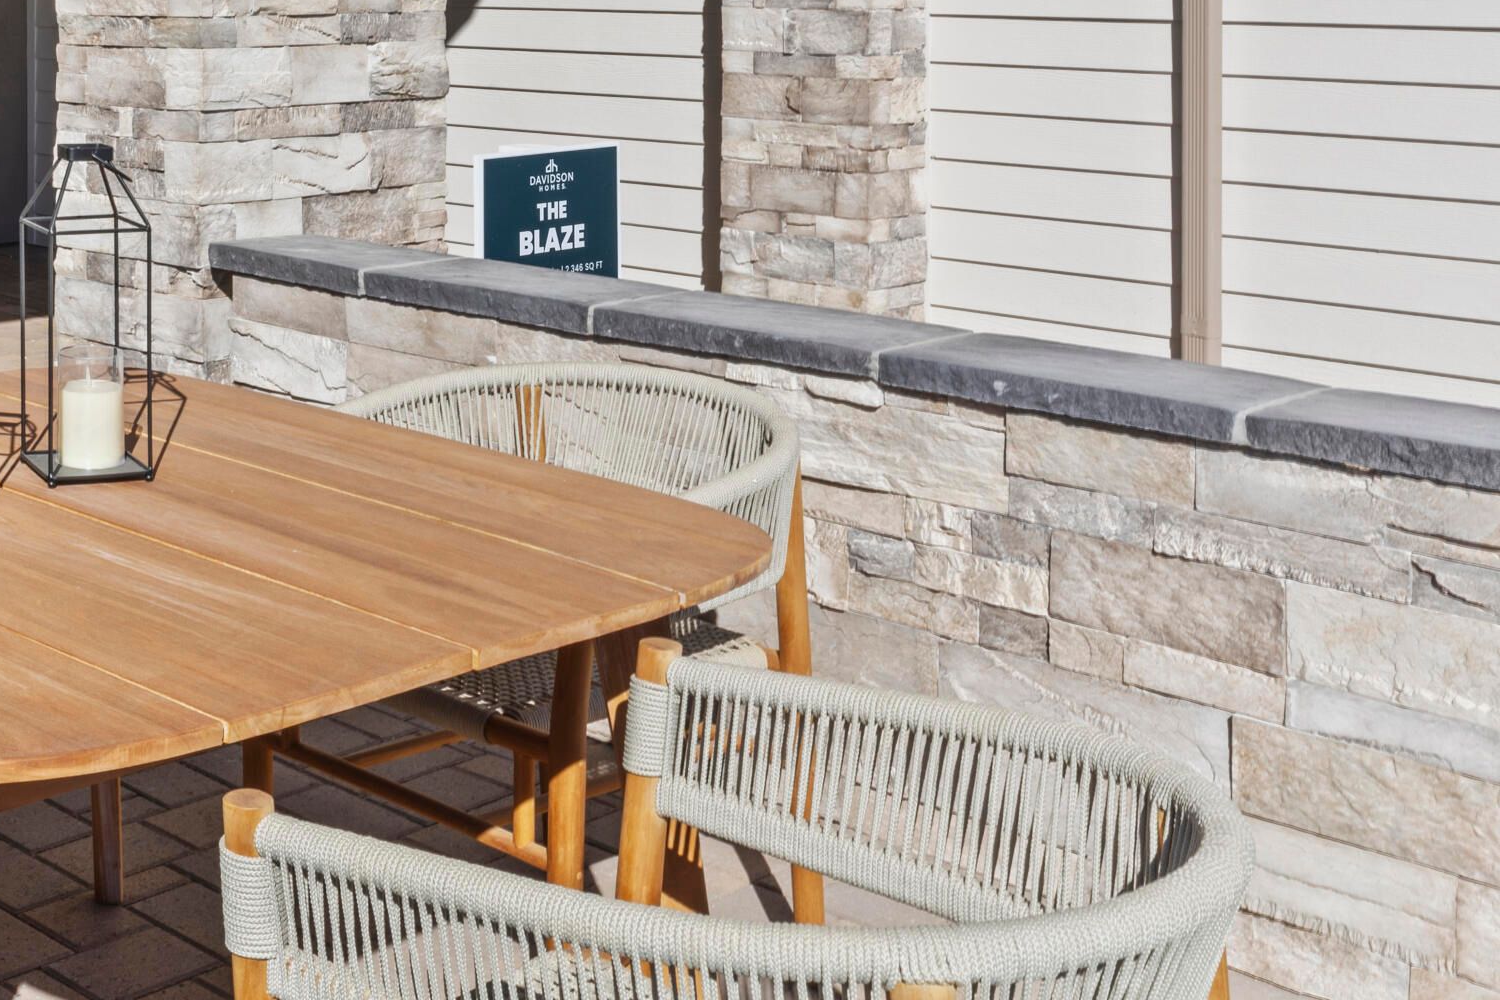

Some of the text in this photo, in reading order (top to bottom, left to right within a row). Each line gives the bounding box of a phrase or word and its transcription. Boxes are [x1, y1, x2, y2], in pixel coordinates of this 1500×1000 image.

[529, 172, 574, 186] DAVIDSON
[539, 183, 566, 192] HOMES
[536, 200, 567, 221] THE
[519, 223, 585, 256] BLAZE
[564, 263, 584, 273] 2346
[584, 261, 595, 271] SQ
[595, 260, 603, 269] FT
